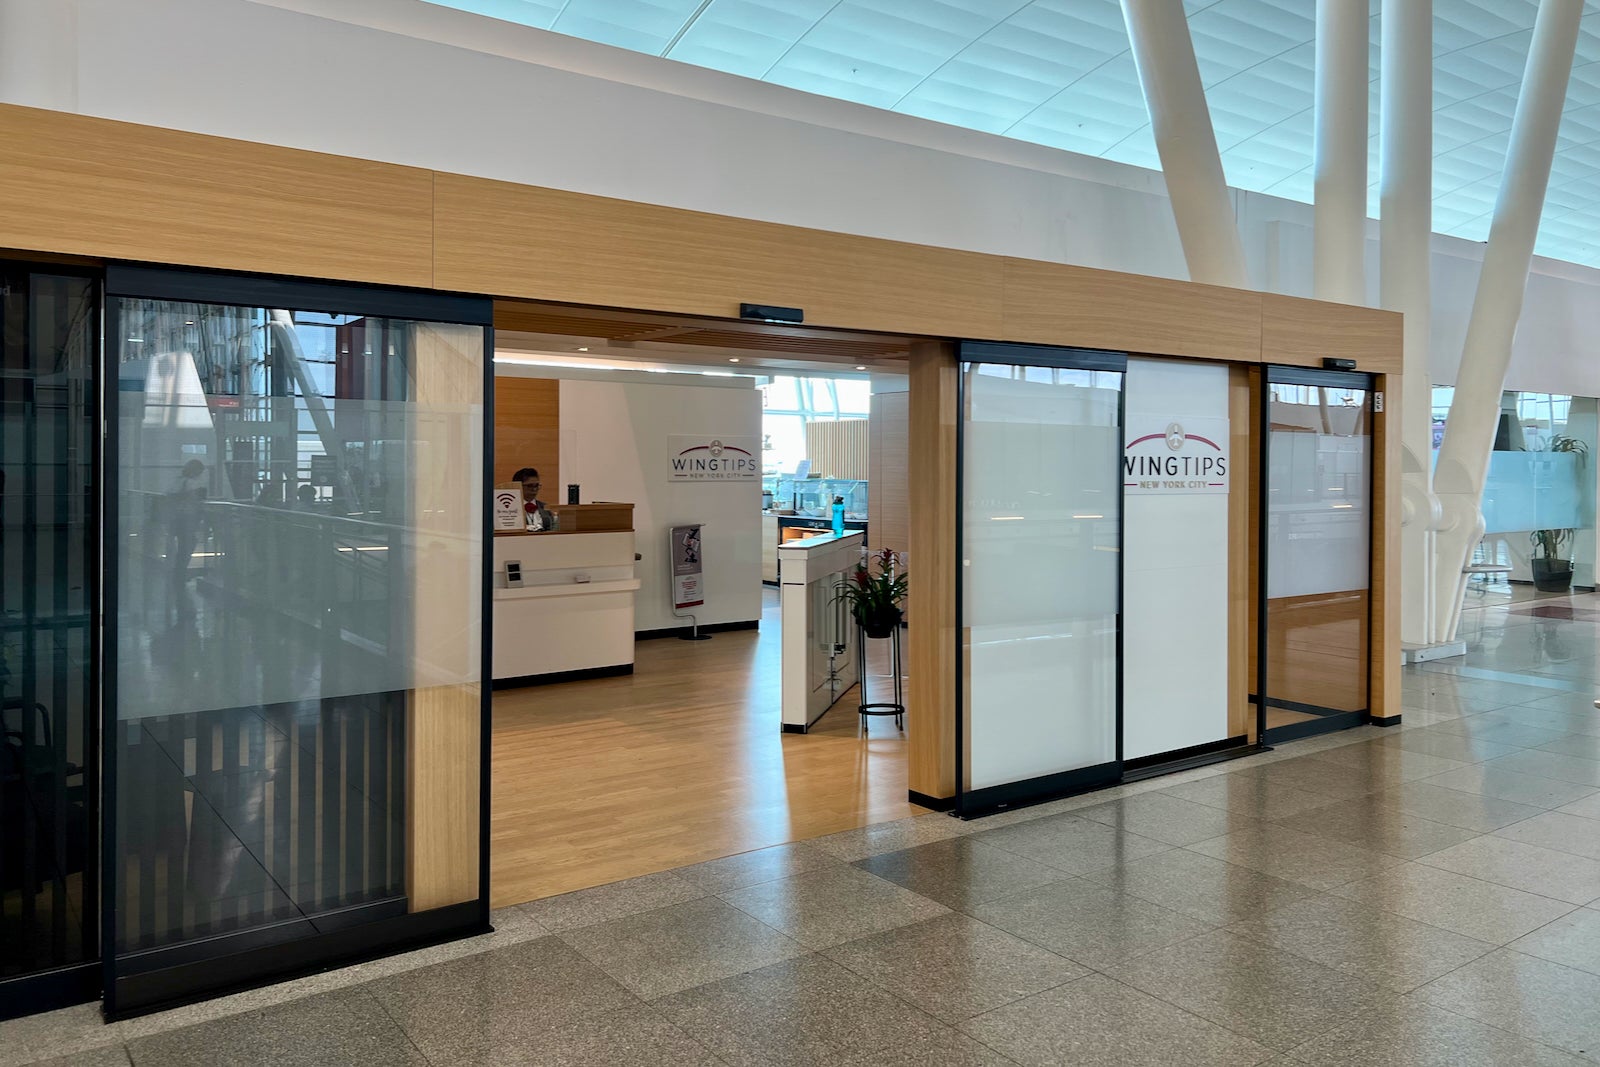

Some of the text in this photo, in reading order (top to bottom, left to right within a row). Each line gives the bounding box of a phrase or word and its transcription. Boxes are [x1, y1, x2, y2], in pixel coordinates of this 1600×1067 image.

[672, 458, 757, 471] WINGTIPS
[1139, 480, 1208, 489] NEW YORK CITY
